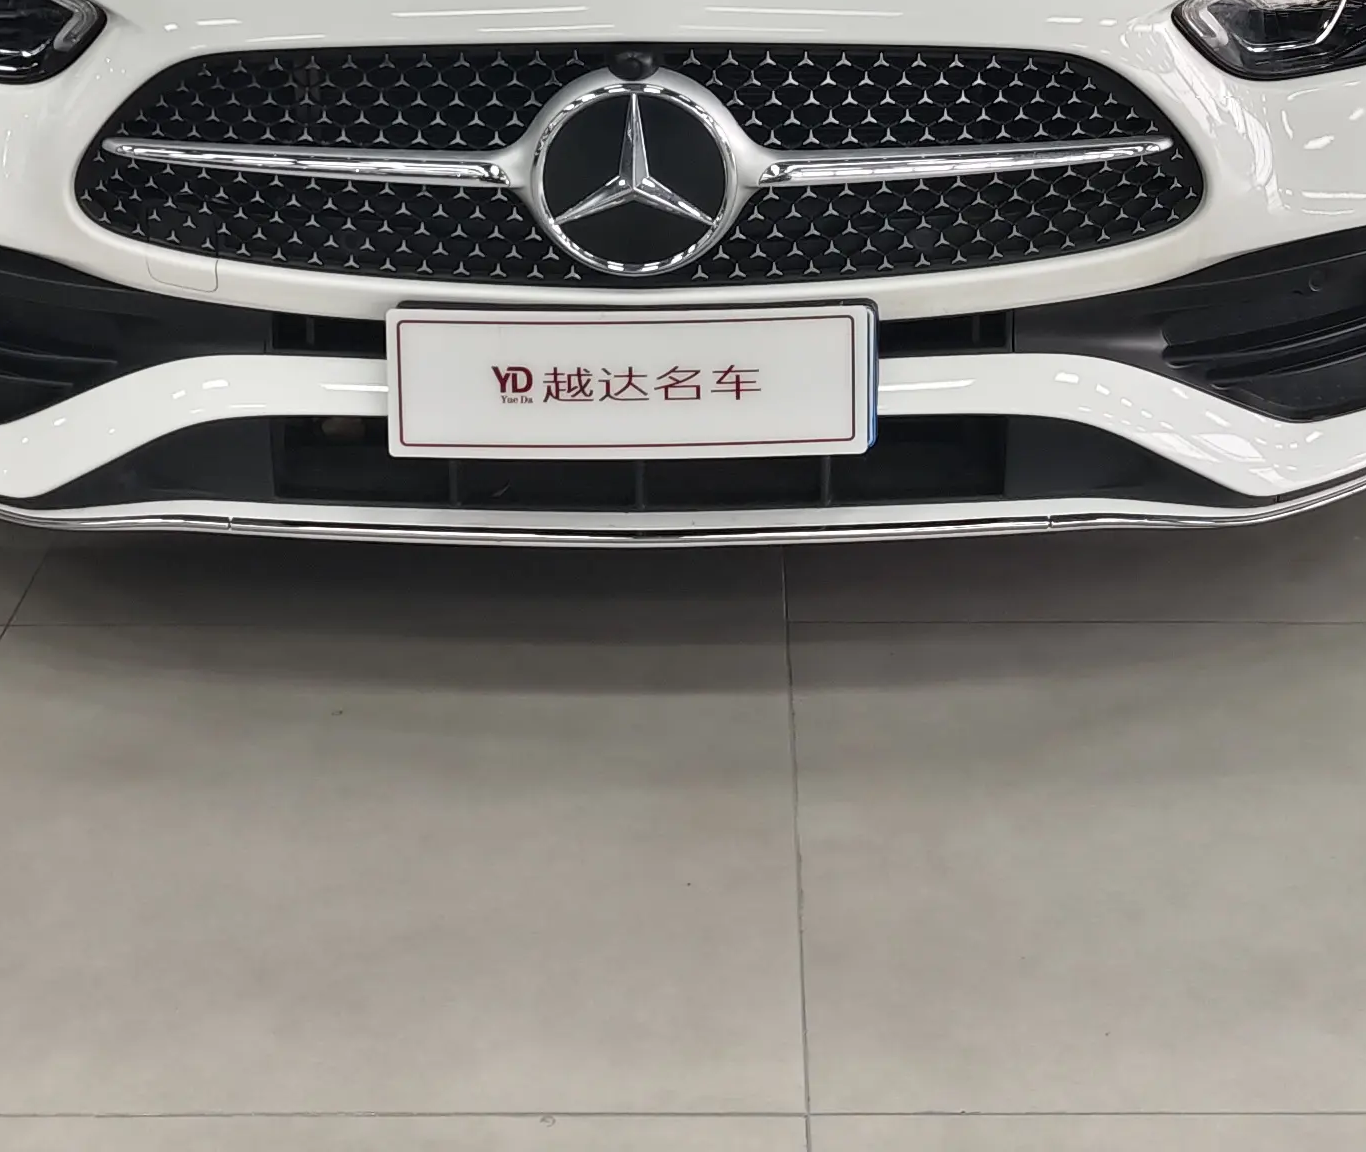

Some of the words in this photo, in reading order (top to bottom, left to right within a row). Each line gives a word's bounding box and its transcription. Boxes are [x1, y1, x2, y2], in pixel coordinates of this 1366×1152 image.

[491, 365, 533, 393] YD
[542, 365, 762, 403] 越达名车
[520, 395, 533, 403] Da
